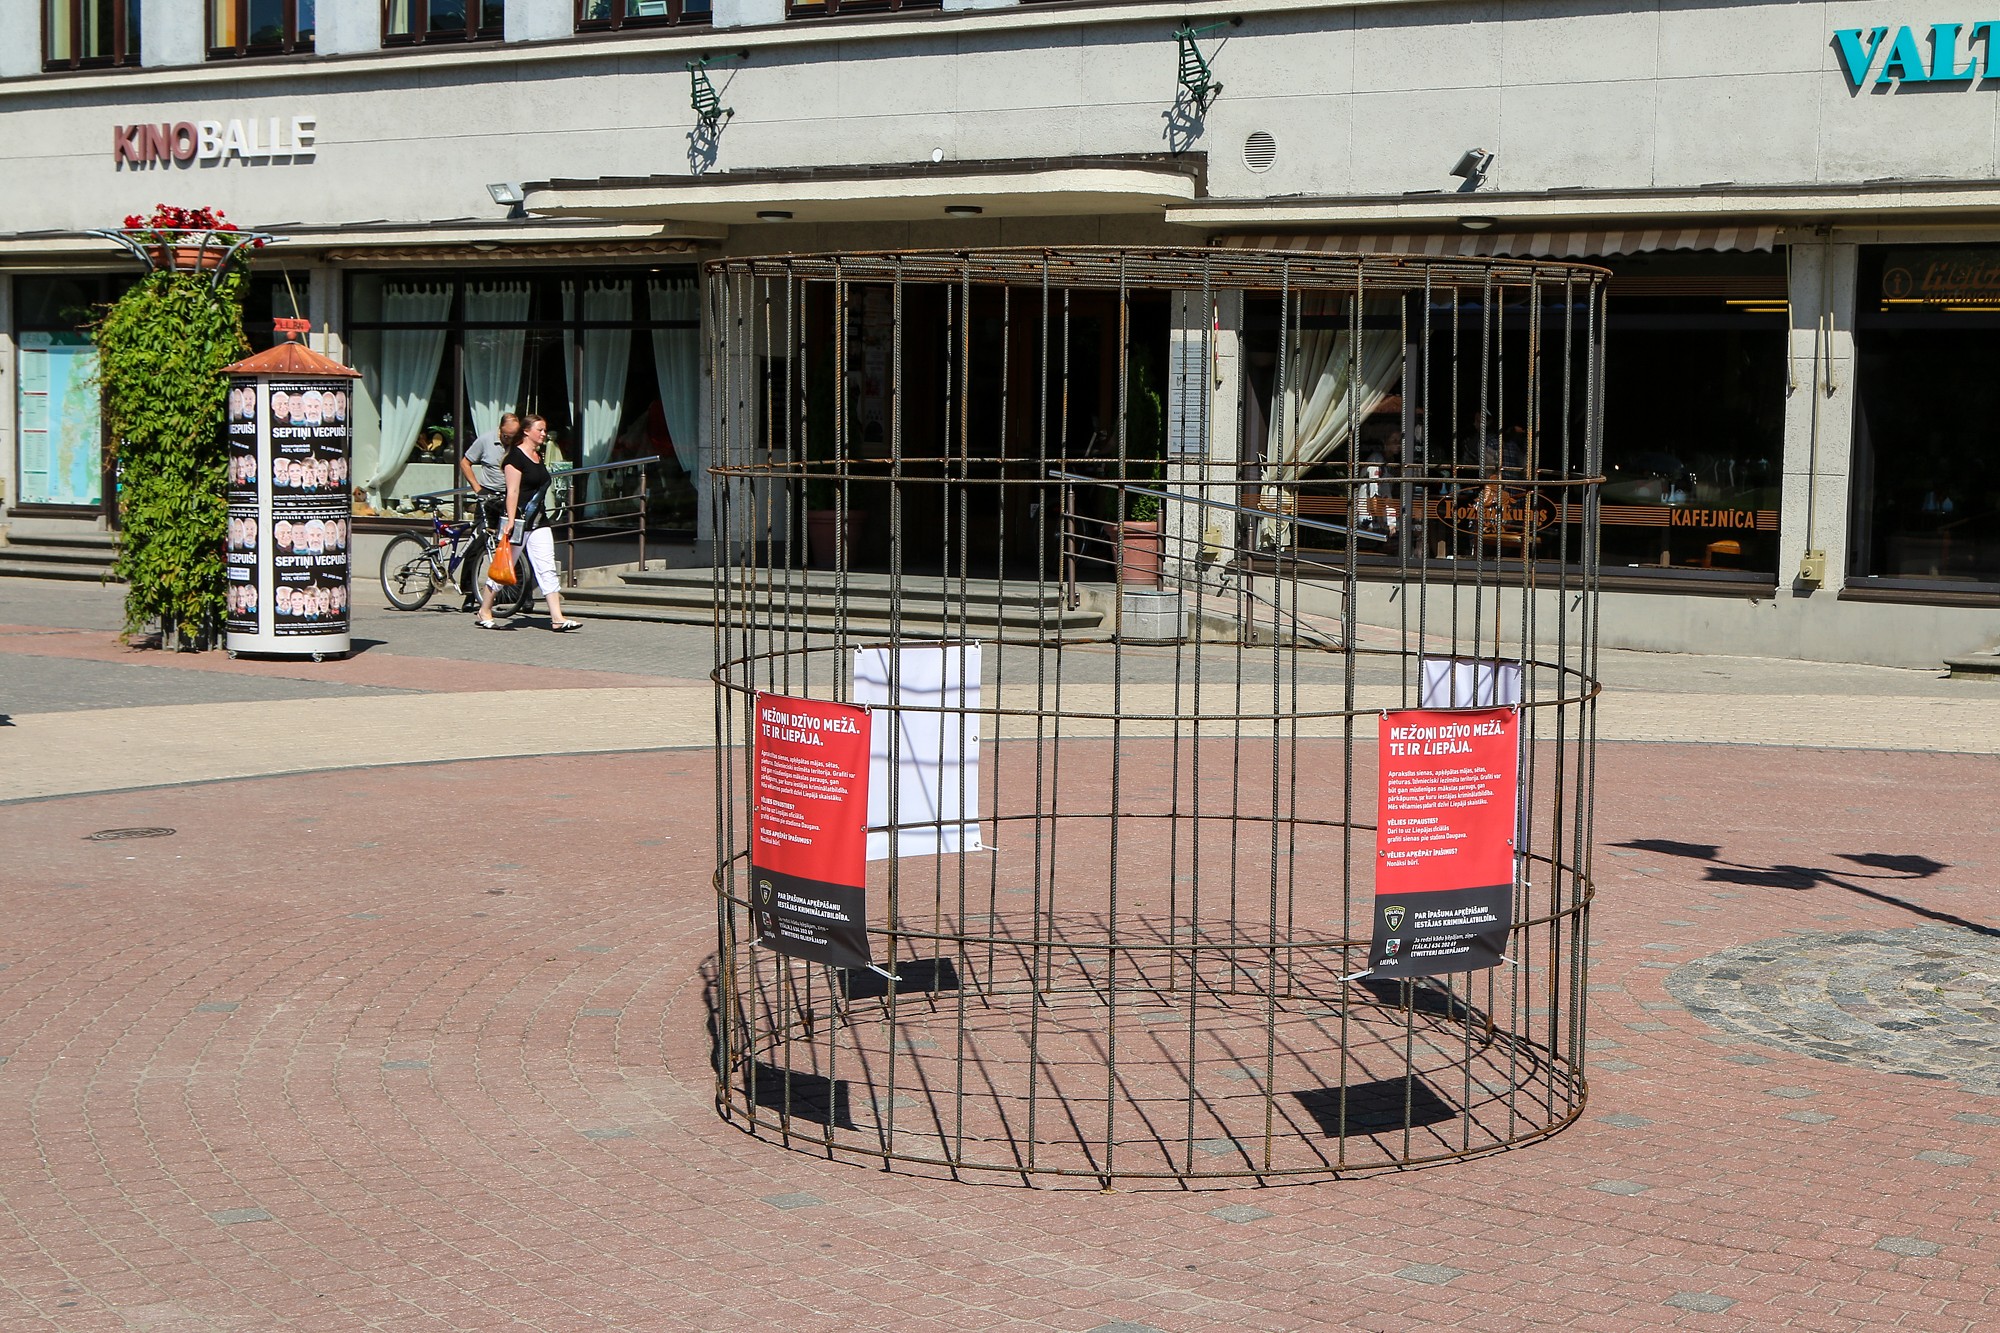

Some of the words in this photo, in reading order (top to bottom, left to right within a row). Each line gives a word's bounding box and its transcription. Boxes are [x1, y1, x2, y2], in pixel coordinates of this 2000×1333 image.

[114, 116, 316, 162] KINOBALLE
[229, 422, 256, 434] ECPUIŠI
[272, 427, 311, 440] SEPTIŅI
[313, 424, 346, 437] VECPUIŠI
[1672, 508, 1755, 529] KAFEJNĪCA
[276, 556, 313, 568] SEPTIŅI
[315, 553, 346, 566] VECPUIŠI
[762, 707, 789, 728] MEŽOŅI
[792, 714, 820, 730] DZĪVO
[824, 716, 860, 734] MEŽĀ.
[762, 724, 770, 737] TE
[772, 726, 780, 739] IR
[782, 729, 824, 746] LIEPĀJA.
[1390, 724, 1436, 742] MEŽOŅI
[1440, 723, 1470, 739] DZĪVO
[1473, 720, 1504, 736] MEŽĀ.
[1390, 743, 1404, 756] TE
[1407, 743, 1420, 755] IR
[1424, 739, 1472, 755] LIEPĀJA.
[1406, 849, 1432, 859] APĶĒPĀT
[778, 901, 797, 911] IESTĀJAS
[1428, 909, 1453, 918] ĪPAŠUMA
[1454, 906, 1488, 917] APĶĒPĀŠANU
[1414, 919, 1442, 928] IESTĀJAS
[1443, 914, 1497, 926] KRIMINĀLATBILDĪBA.
